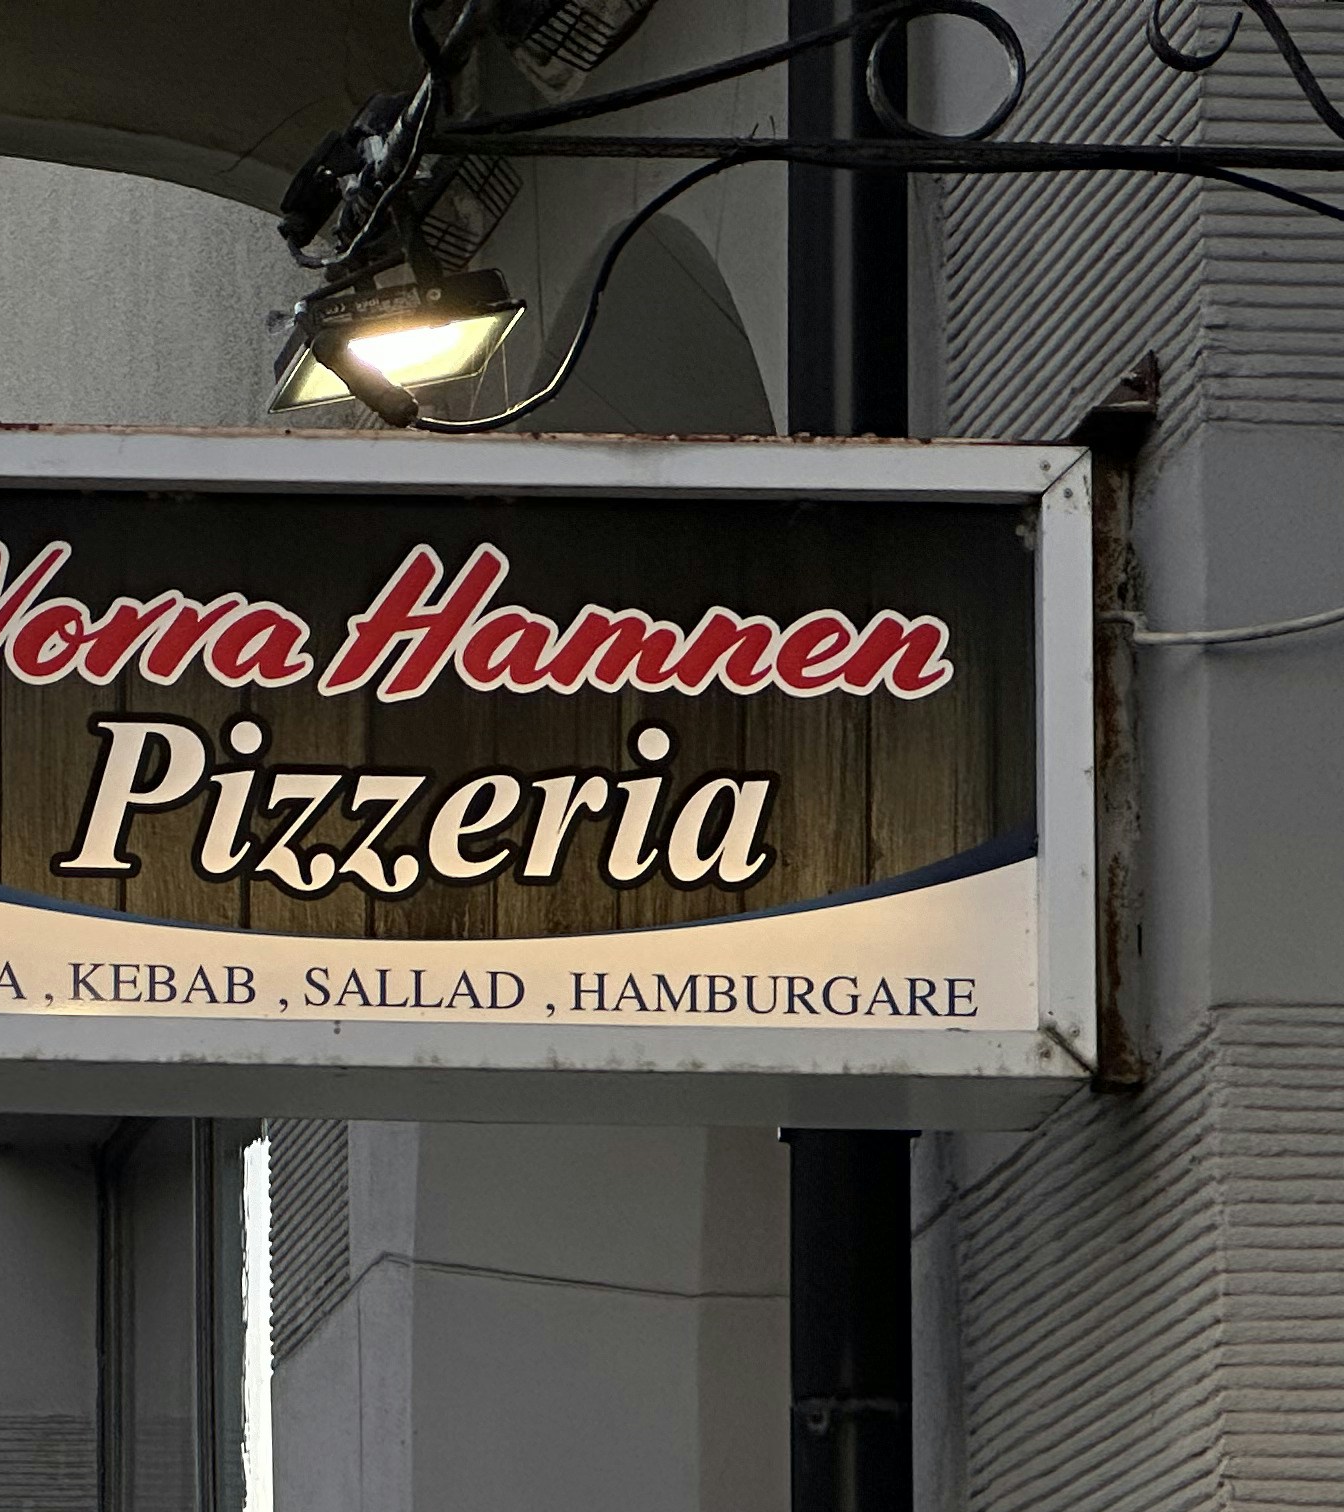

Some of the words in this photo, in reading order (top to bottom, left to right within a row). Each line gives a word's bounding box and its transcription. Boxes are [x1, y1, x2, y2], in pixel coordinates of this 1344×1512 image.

[318, 542, 955, 702] Hamnen
[58, 719, 774, 891] Pizzeria
[68, 961, 257, 1005] KEBAB
[304, 966, 527, 1011] SALLAD
[569, 971, 979, 1019] HAMBURGARE
